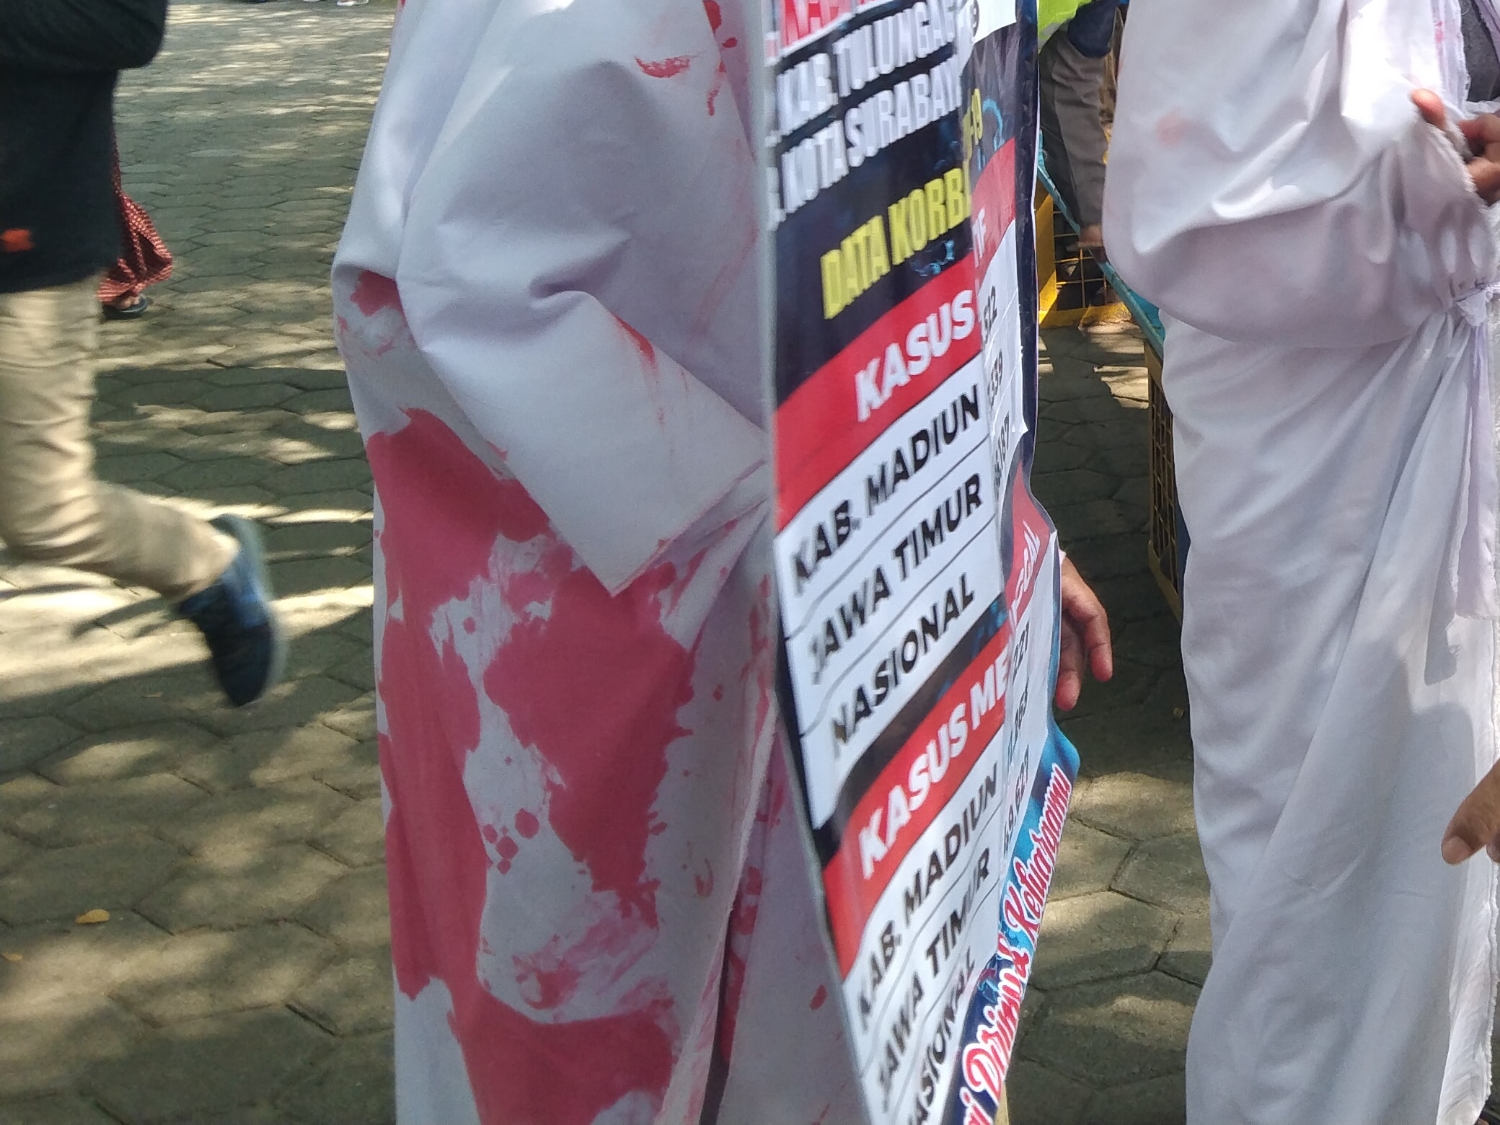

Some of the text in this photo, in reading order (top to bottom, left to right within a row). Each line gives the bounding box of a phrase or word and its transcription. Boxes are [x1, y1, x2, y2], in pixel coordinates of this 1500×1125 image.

[821, 215, 890, 320] DATA
[888, 167, 972, 266] KORB
[855, 289, 976, 422] KASUS
[790, 383, 980, 598] KAB. MADIUN
[813, 473, 982, 685] JAWA TIMUR
[832, 572, 976, 759] NASIONAL
[858, 700, 967, 880] KASUS
[858, 763, 998, 1035] KAB. MADIUN
[925, 847, 990, 979] TIMUR
[906, 947, 975, 1125] ASIONAL
